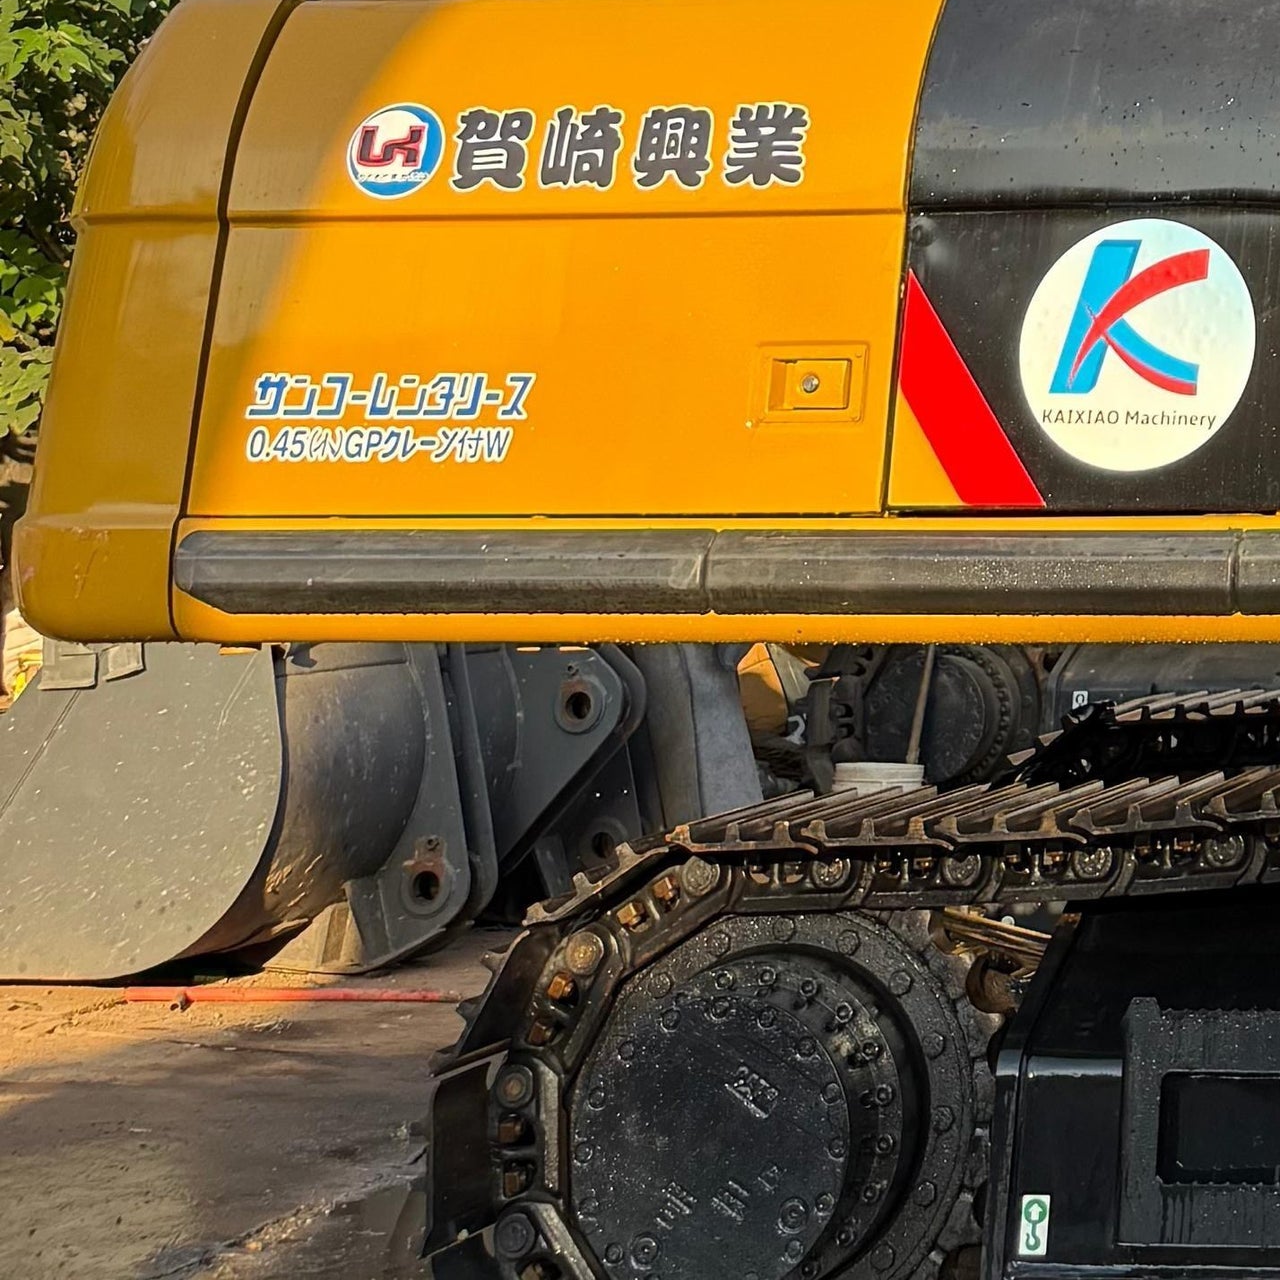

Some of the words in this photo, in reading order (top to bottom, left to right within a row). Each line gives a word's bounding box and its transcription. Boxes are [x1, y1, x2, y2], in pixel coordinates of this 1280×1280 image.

[451, 103, 810, 191] 賀崎興業
[247, 374, 534, 418] サンコーレンタリース
[1041, 408, 1120, 425] KAIXIAO
[1124, 409, 1218, 431] Machinery
